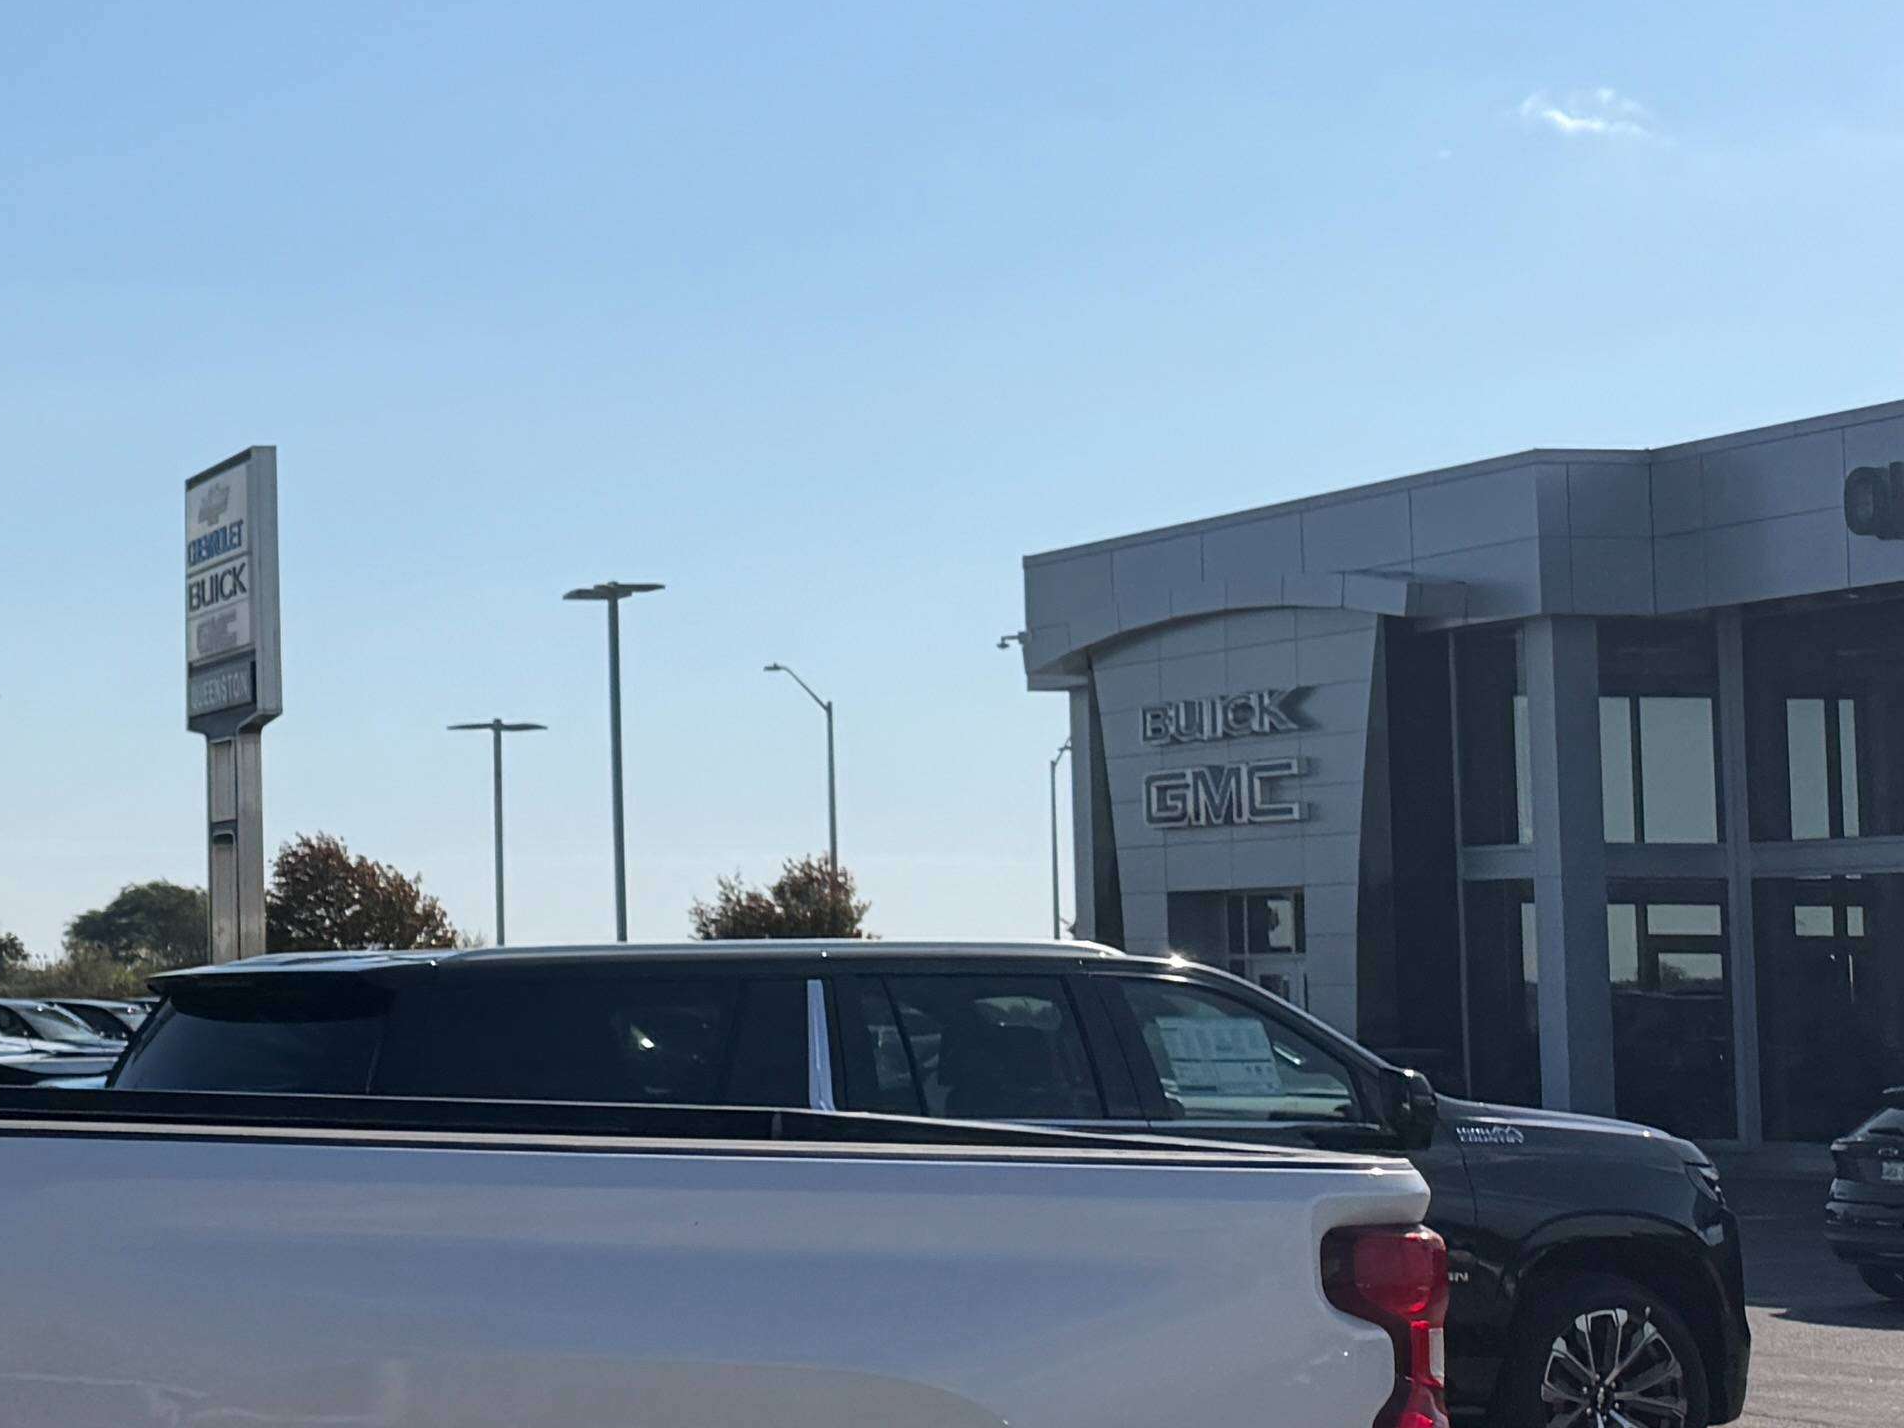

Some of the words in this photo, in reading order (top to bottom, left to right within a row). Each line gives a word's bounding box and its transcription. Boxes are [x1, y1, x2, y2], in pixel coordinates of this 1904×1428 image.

[188, 562, 247, 612] BUICK
[1140, 690, 1300, 746] BUICK
[1145, 758, 1300, 829] GMC
